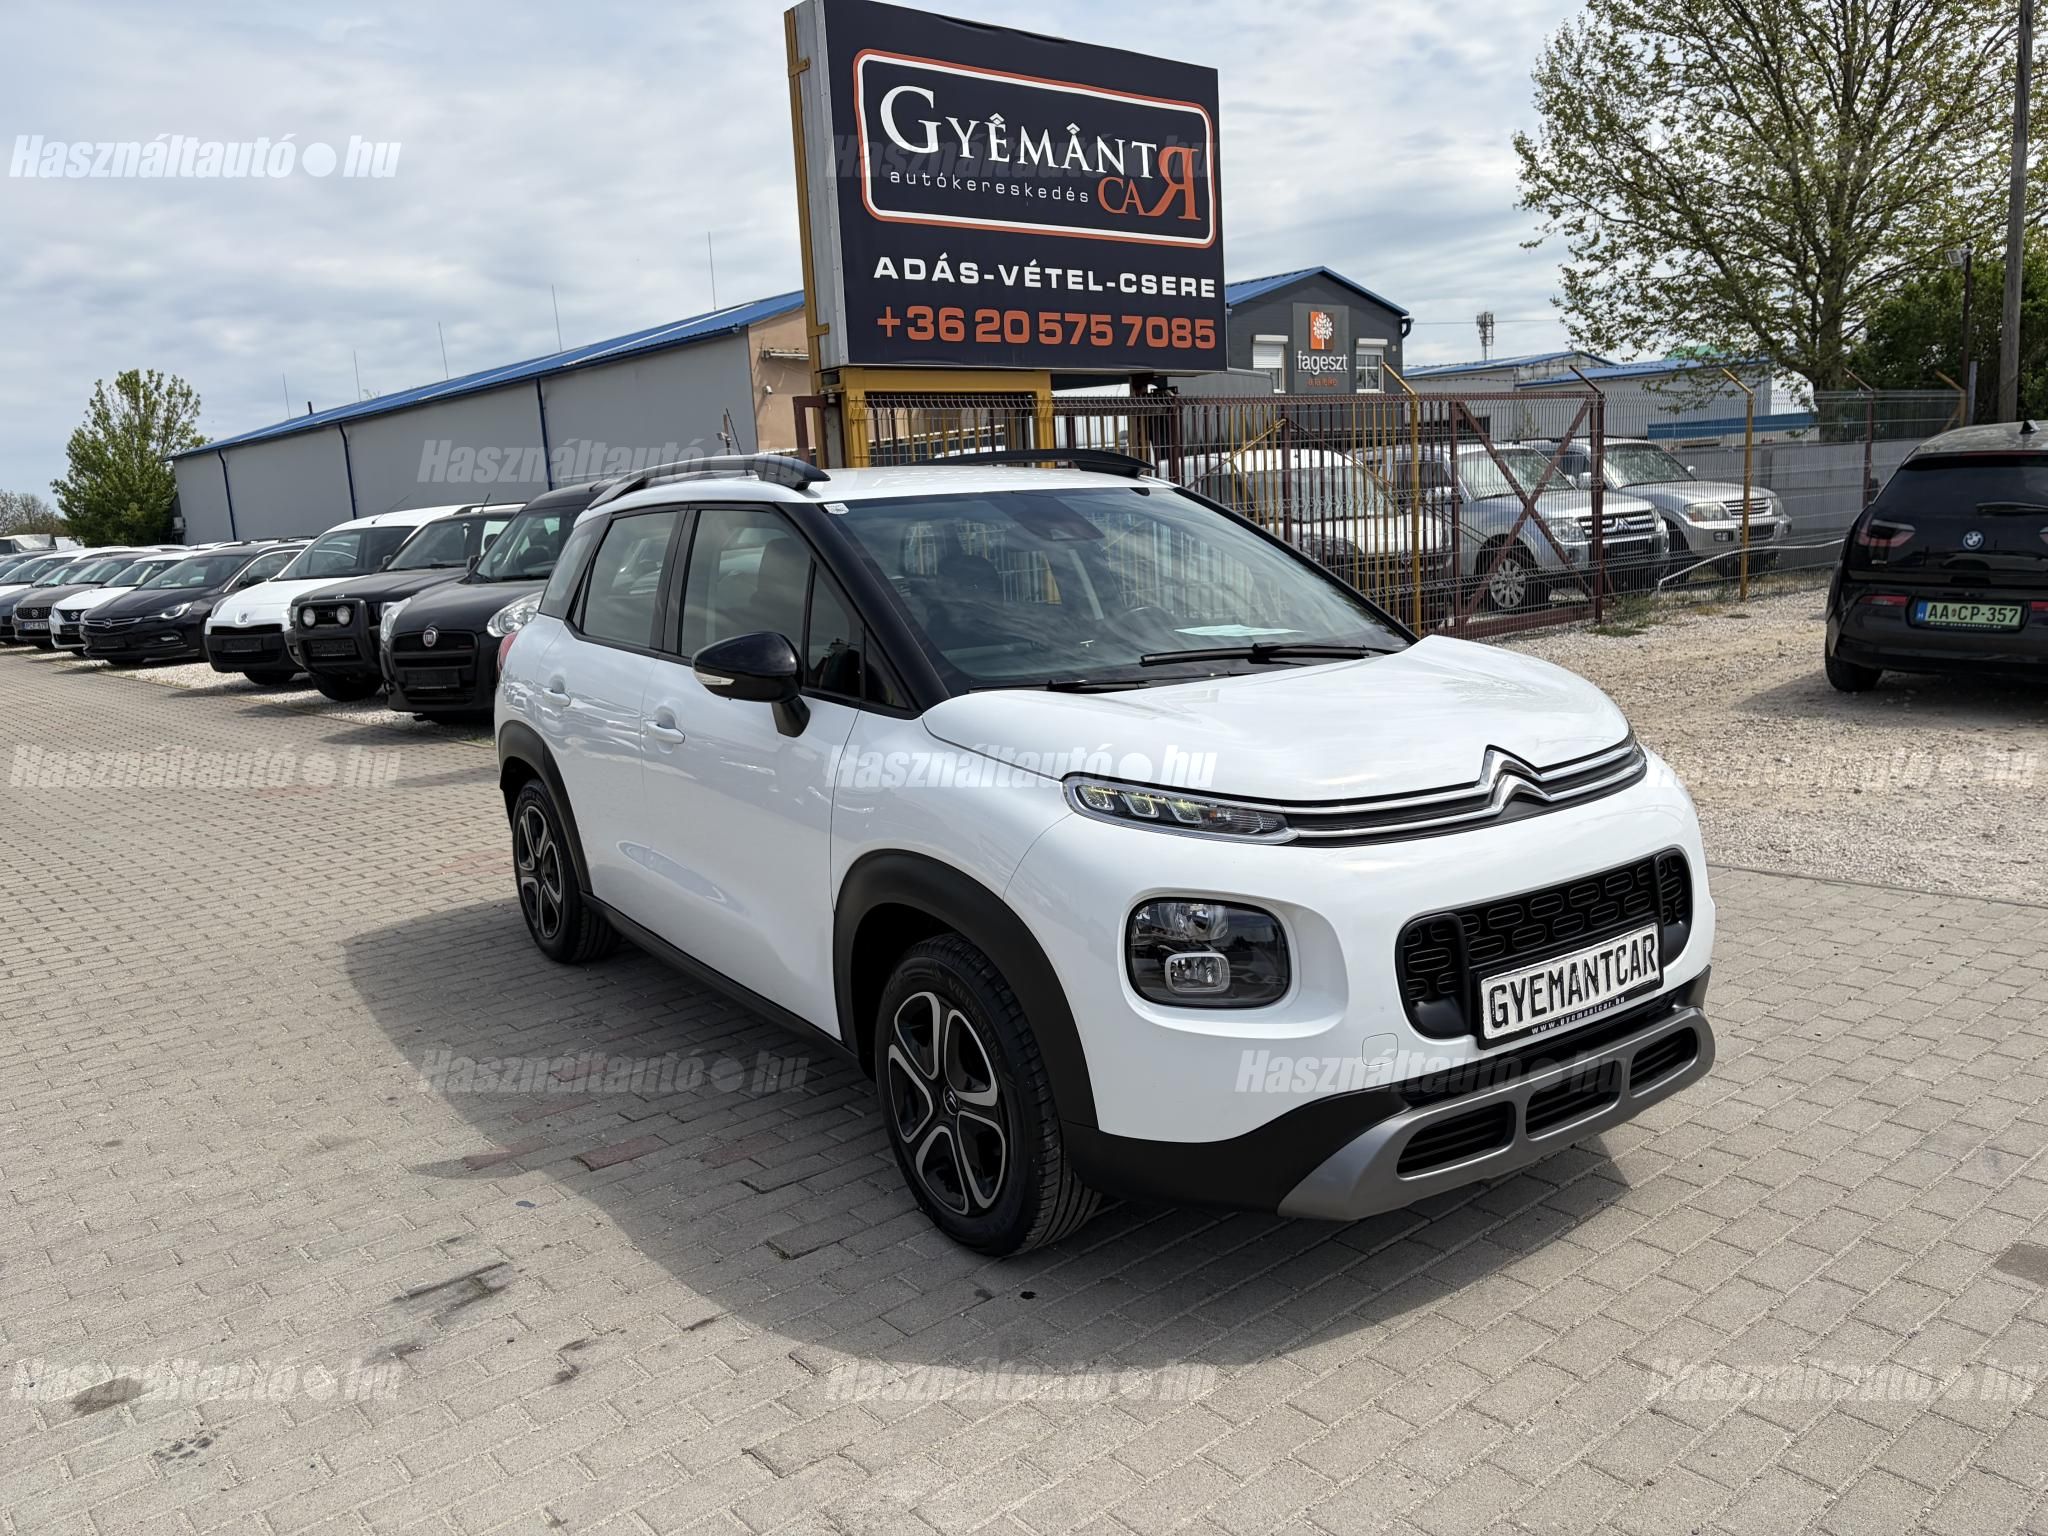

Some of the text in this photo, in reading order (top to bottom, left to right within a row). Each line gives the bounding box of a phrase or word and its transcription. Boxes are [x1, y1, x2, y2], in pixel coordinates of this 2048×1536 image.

[889, 169, 1090, 204] autókereskedés
[873, 252, 1217, 299] ADÁS-VÉTEL-CSERE
[876, 304, 1217, 350] +36 20 575 7085
[1297, 350, 1348, 376] fageszt
[1489, 932, 1657, 1029] GYEMANTCAR
